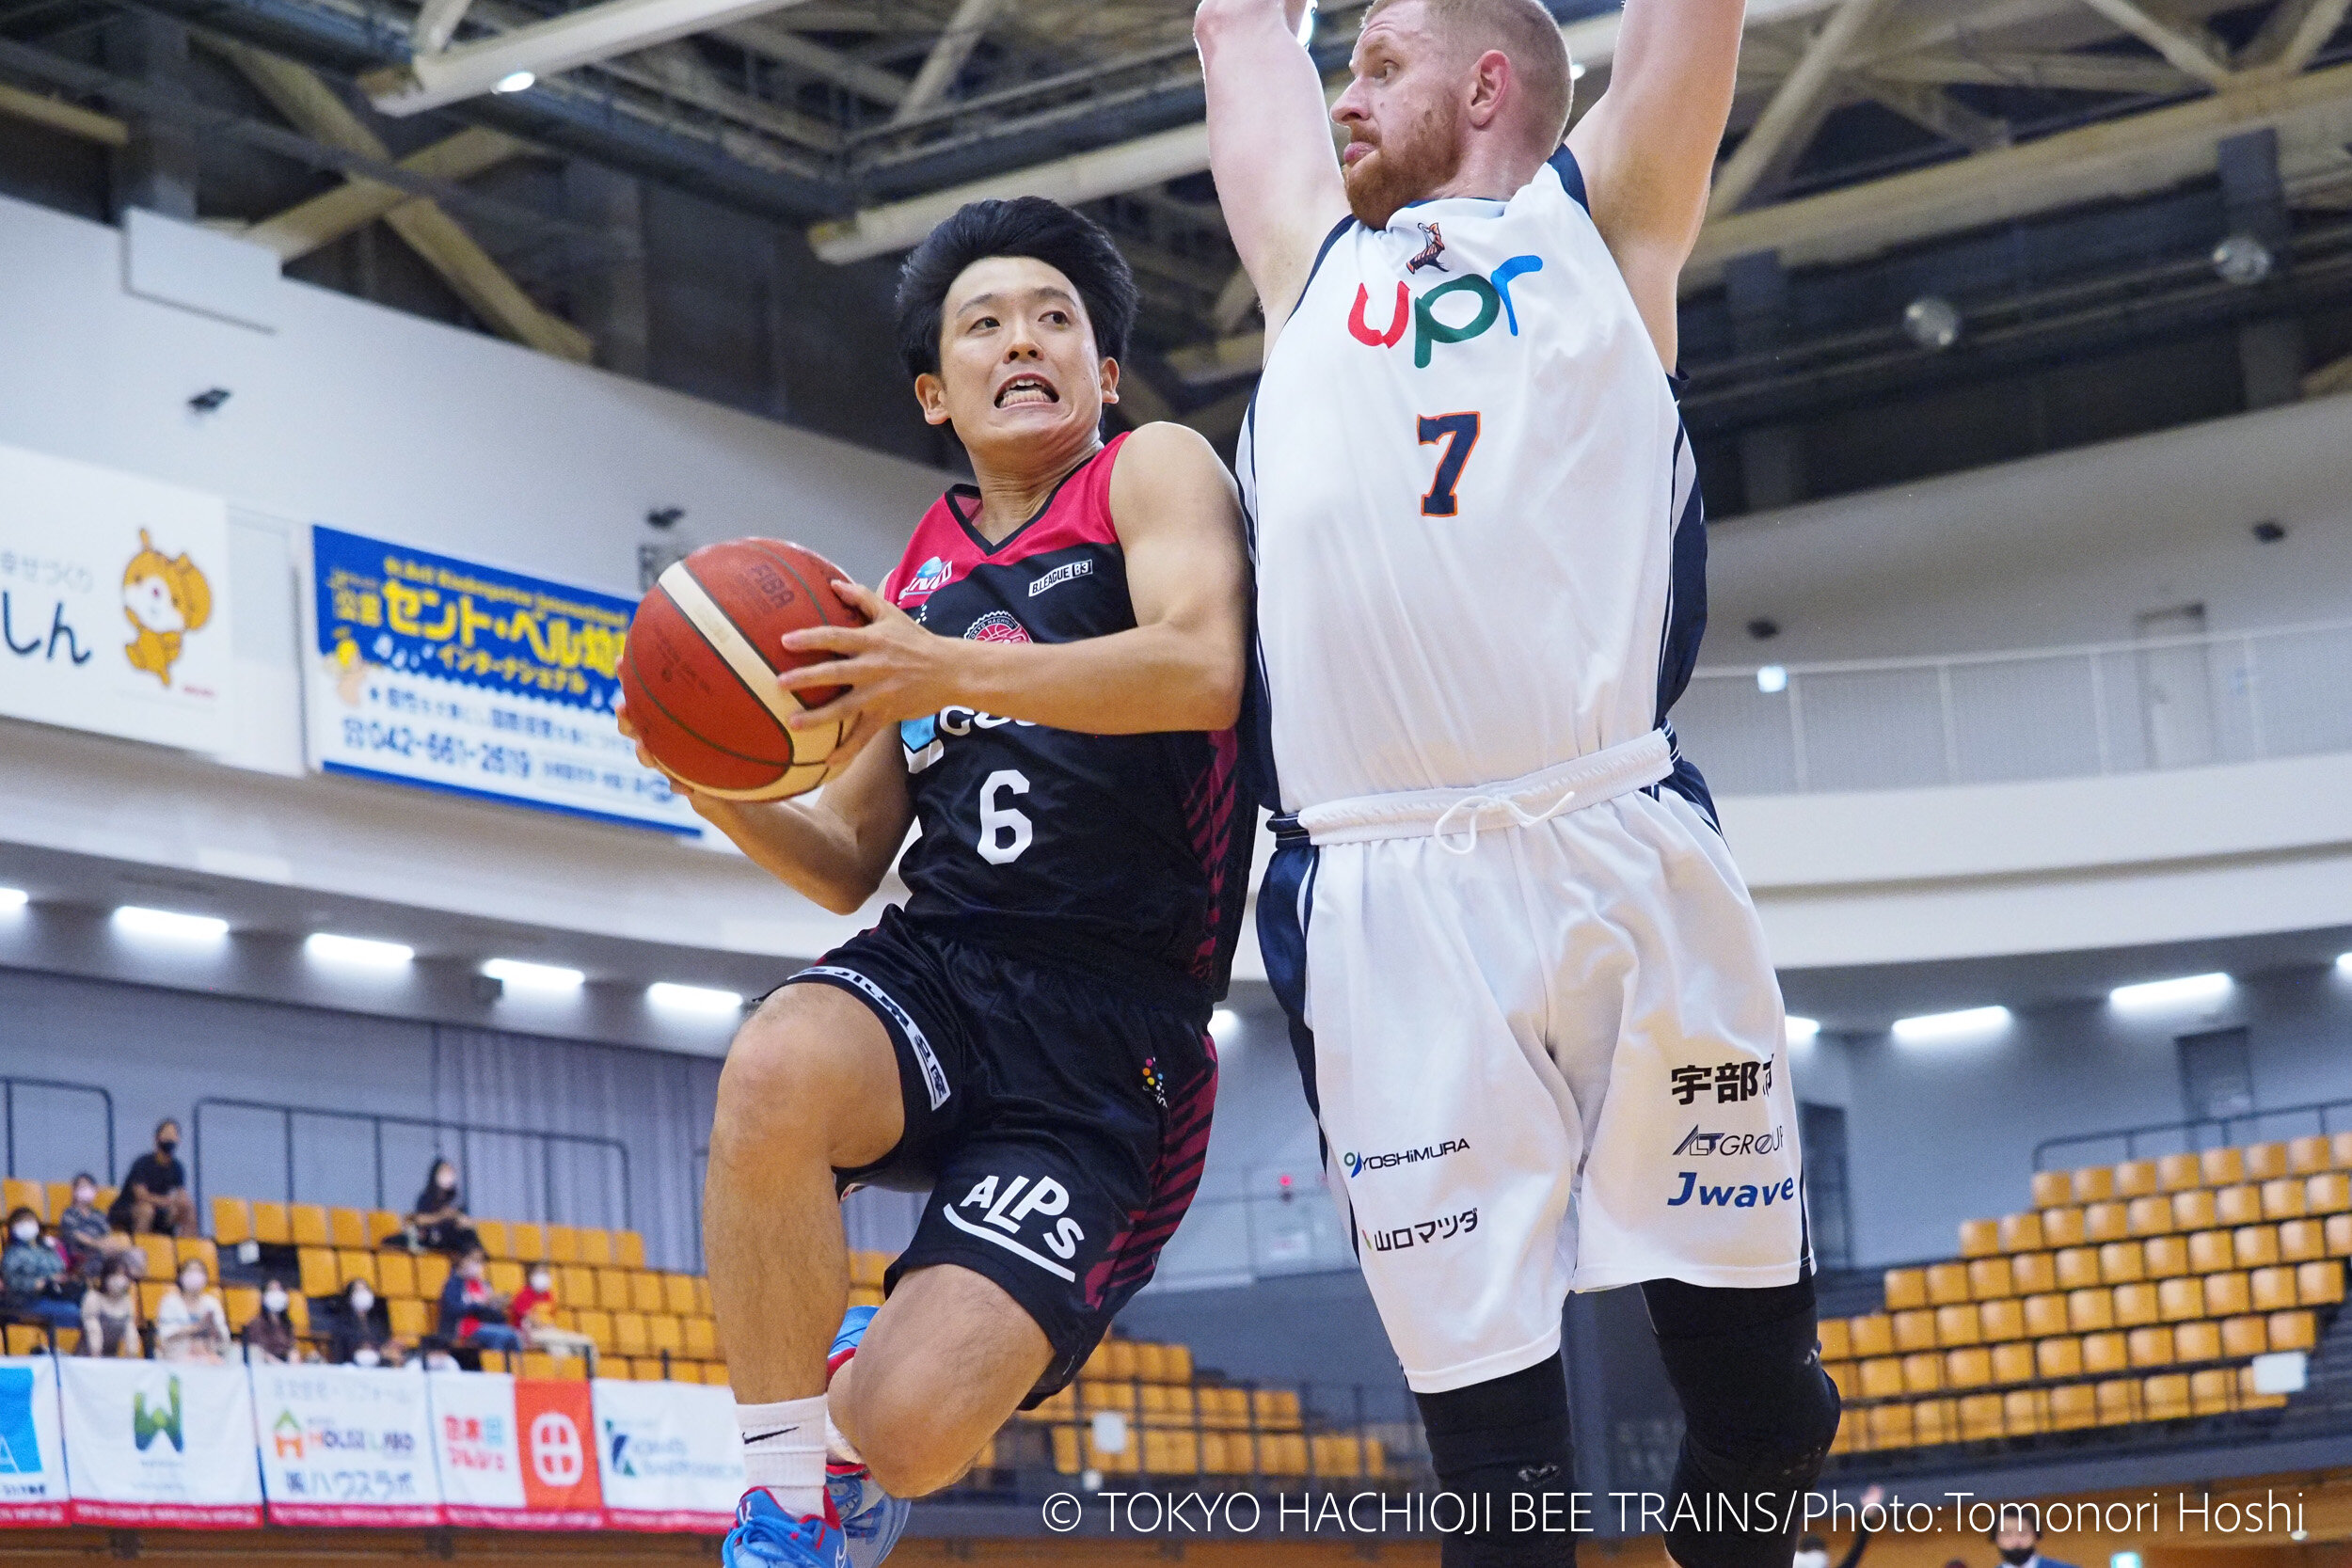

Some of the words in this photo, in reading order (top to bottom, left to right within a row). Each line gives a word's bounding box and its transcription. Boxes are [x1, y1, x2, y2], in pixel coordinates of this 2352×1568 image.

[1347, 254, 1544, 370] upr
[1416, 411, 1481, 517] 7
[751, 563, 796, 610] FIBA
[1031, 565, 1070, 594] B.LEAGUE
[1073, 562, 1090, 577] B3
[977, 768, 1034, 865] 6
[960, 1175, 1085, 1259] ALPS
[1667, 1171, 1794, 1208] Jwave
[1374, 1208, 1478, 1252] 山口マツダ
